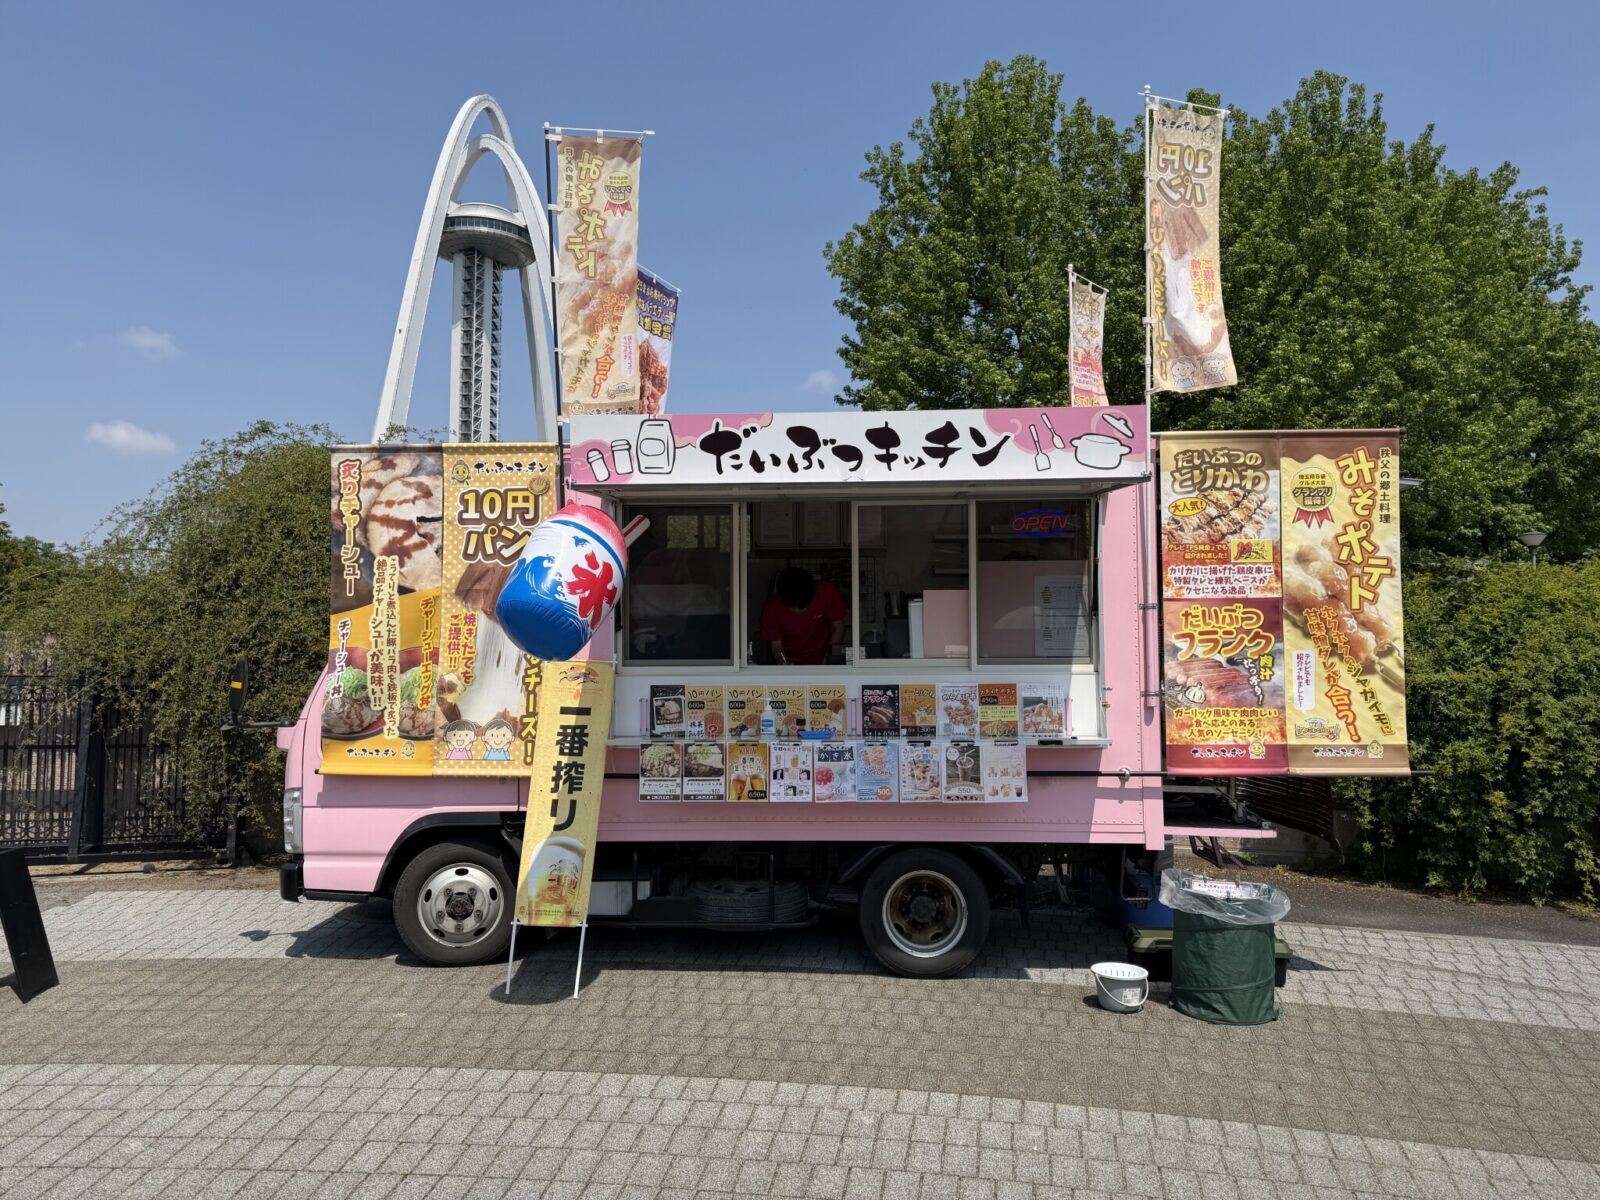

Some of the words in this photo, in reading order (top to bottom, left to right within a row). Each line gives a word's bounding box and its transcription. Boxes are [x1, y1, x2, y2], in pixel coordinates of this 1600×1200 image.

[698, 421, 1012, 475] だいぶつキッチン
[1176, 450, 1263, 468] だいぶつの
[474, 460, 548, 476] だいぶつキッチン
[1172, 468, 1267, 492] とりかわ
[1293, 487, 1332, 496] グランプリ
[1379, 447, 1391, 524] 秩父の郷土料理
[460, 490, 537, 521] 10円
[1171, 501, 1205, 514] 大人気!
[339, 461, 361, 596] 炙りチャーシュー
[1011, 514, 1070, 531] OPEN
[1336, 448, 1393, 610] みそポテト
[464, 527, 533, 560] パン
[564, 550, 618, 631] 氷
[1181, 604, 1264, 629] だいぶつ
[419, 597, 433, 707] チャーシューエッグ丼
[461, 611, 477, 686] 焼きたてを
[1173, 629, 1275, 660] フランク
[330, 619, 351, 697] チャーシュー丼
[1259, 655, 1274, 681] 肉汁
[688, 690, 722, 699] 10円パン
[729, 690, 762, 698] 10円パン
[769, 690, 803, 699] 10円パン
[810, 690, 844, 699] 10円パン
[1174, 709, 1278, 718] ガーリック風味で肉肉しい
[1194, 719, 1256, 728] 食べ応えのある
[819, 751, 853, 761] かき氷
[550, 706, 592, 832] 一番搾り
